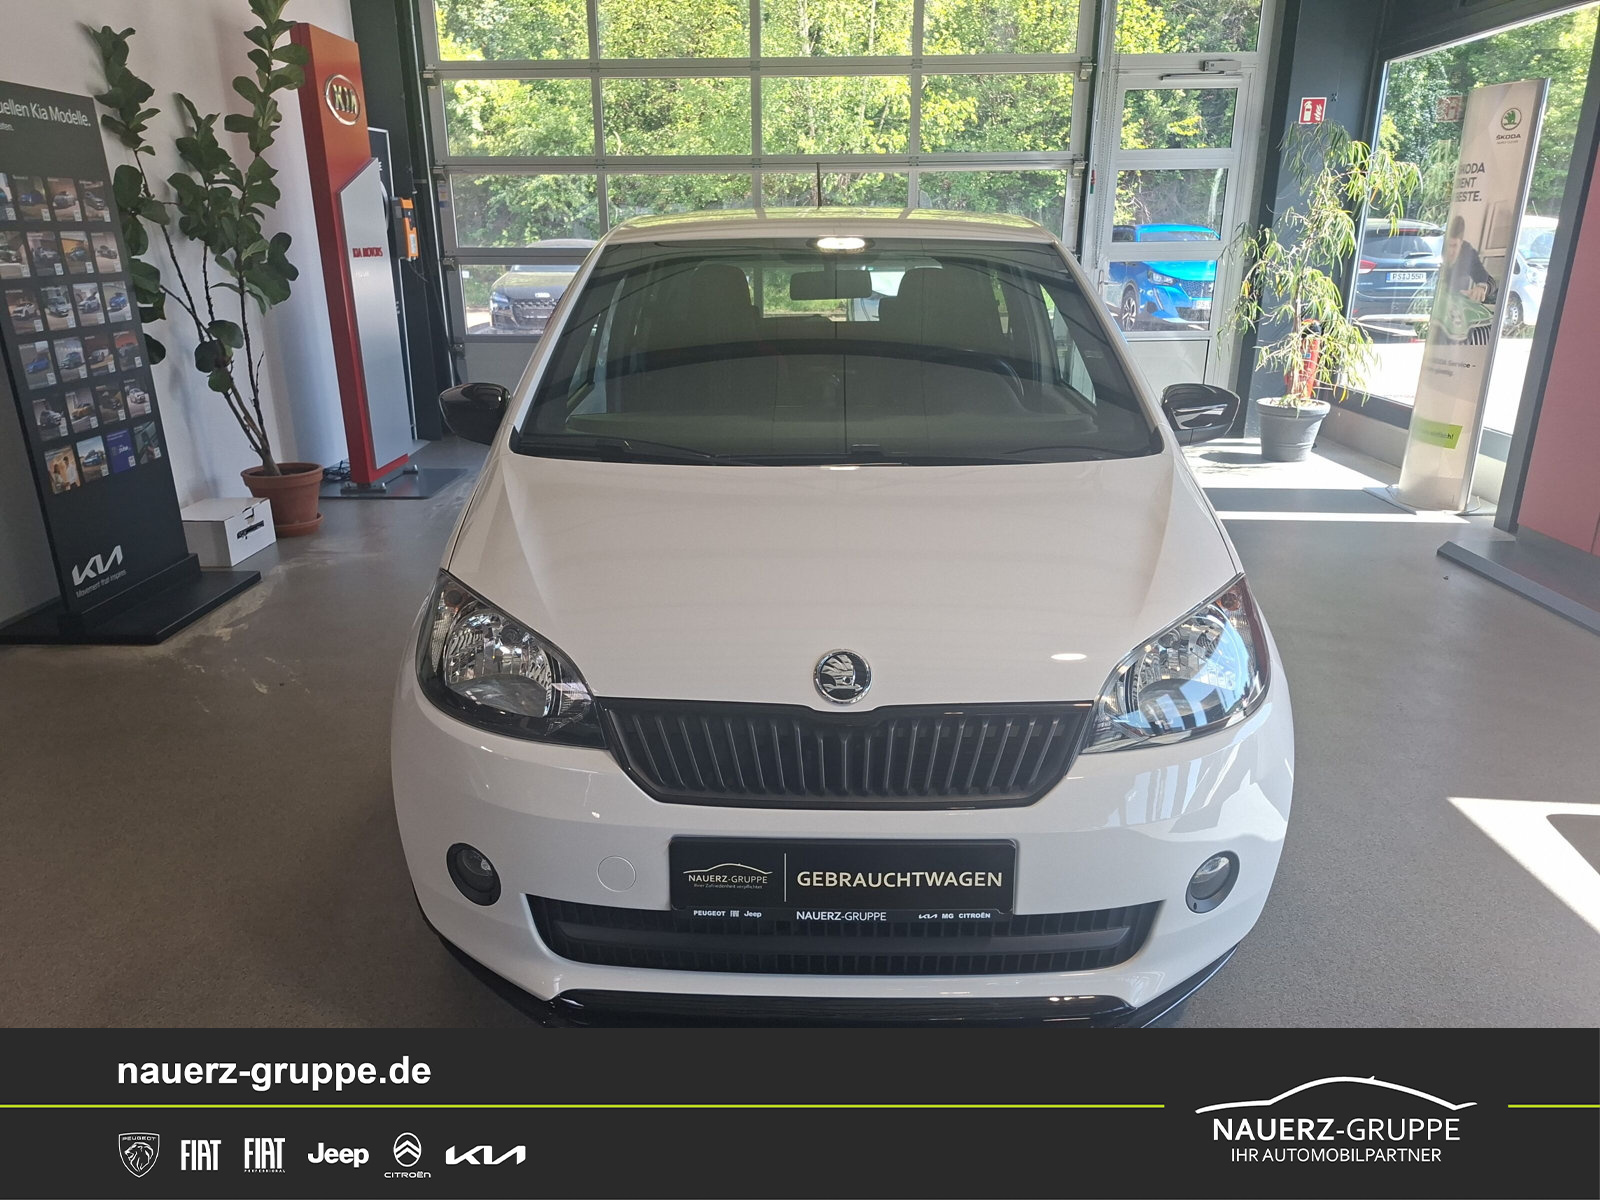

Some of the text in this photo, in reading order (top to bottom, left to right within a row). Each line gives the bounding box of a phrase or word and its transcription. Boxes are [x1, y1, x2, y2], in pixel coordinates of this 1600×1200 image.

[332, 84, 358, 115] KIA
[30, 102, 49, 120] Kia
[49, 105, 92, 127] Modelle.
[71, 544, 123, 586] KIA
[76, 581, 100, 598] Movement
[688, 874, 768, 884] NAUERZ-GRUPPE
[797, 871, 1003, 888] GEBRAUCHTWAGEN
[693, 909, 726, 917] PEUGEOT
[743, 910, 762, 919] Jeep
[796, 910, 887, 922] NAUERZ-GRUPPE
[958, 911, 991, 919] CITROËN
